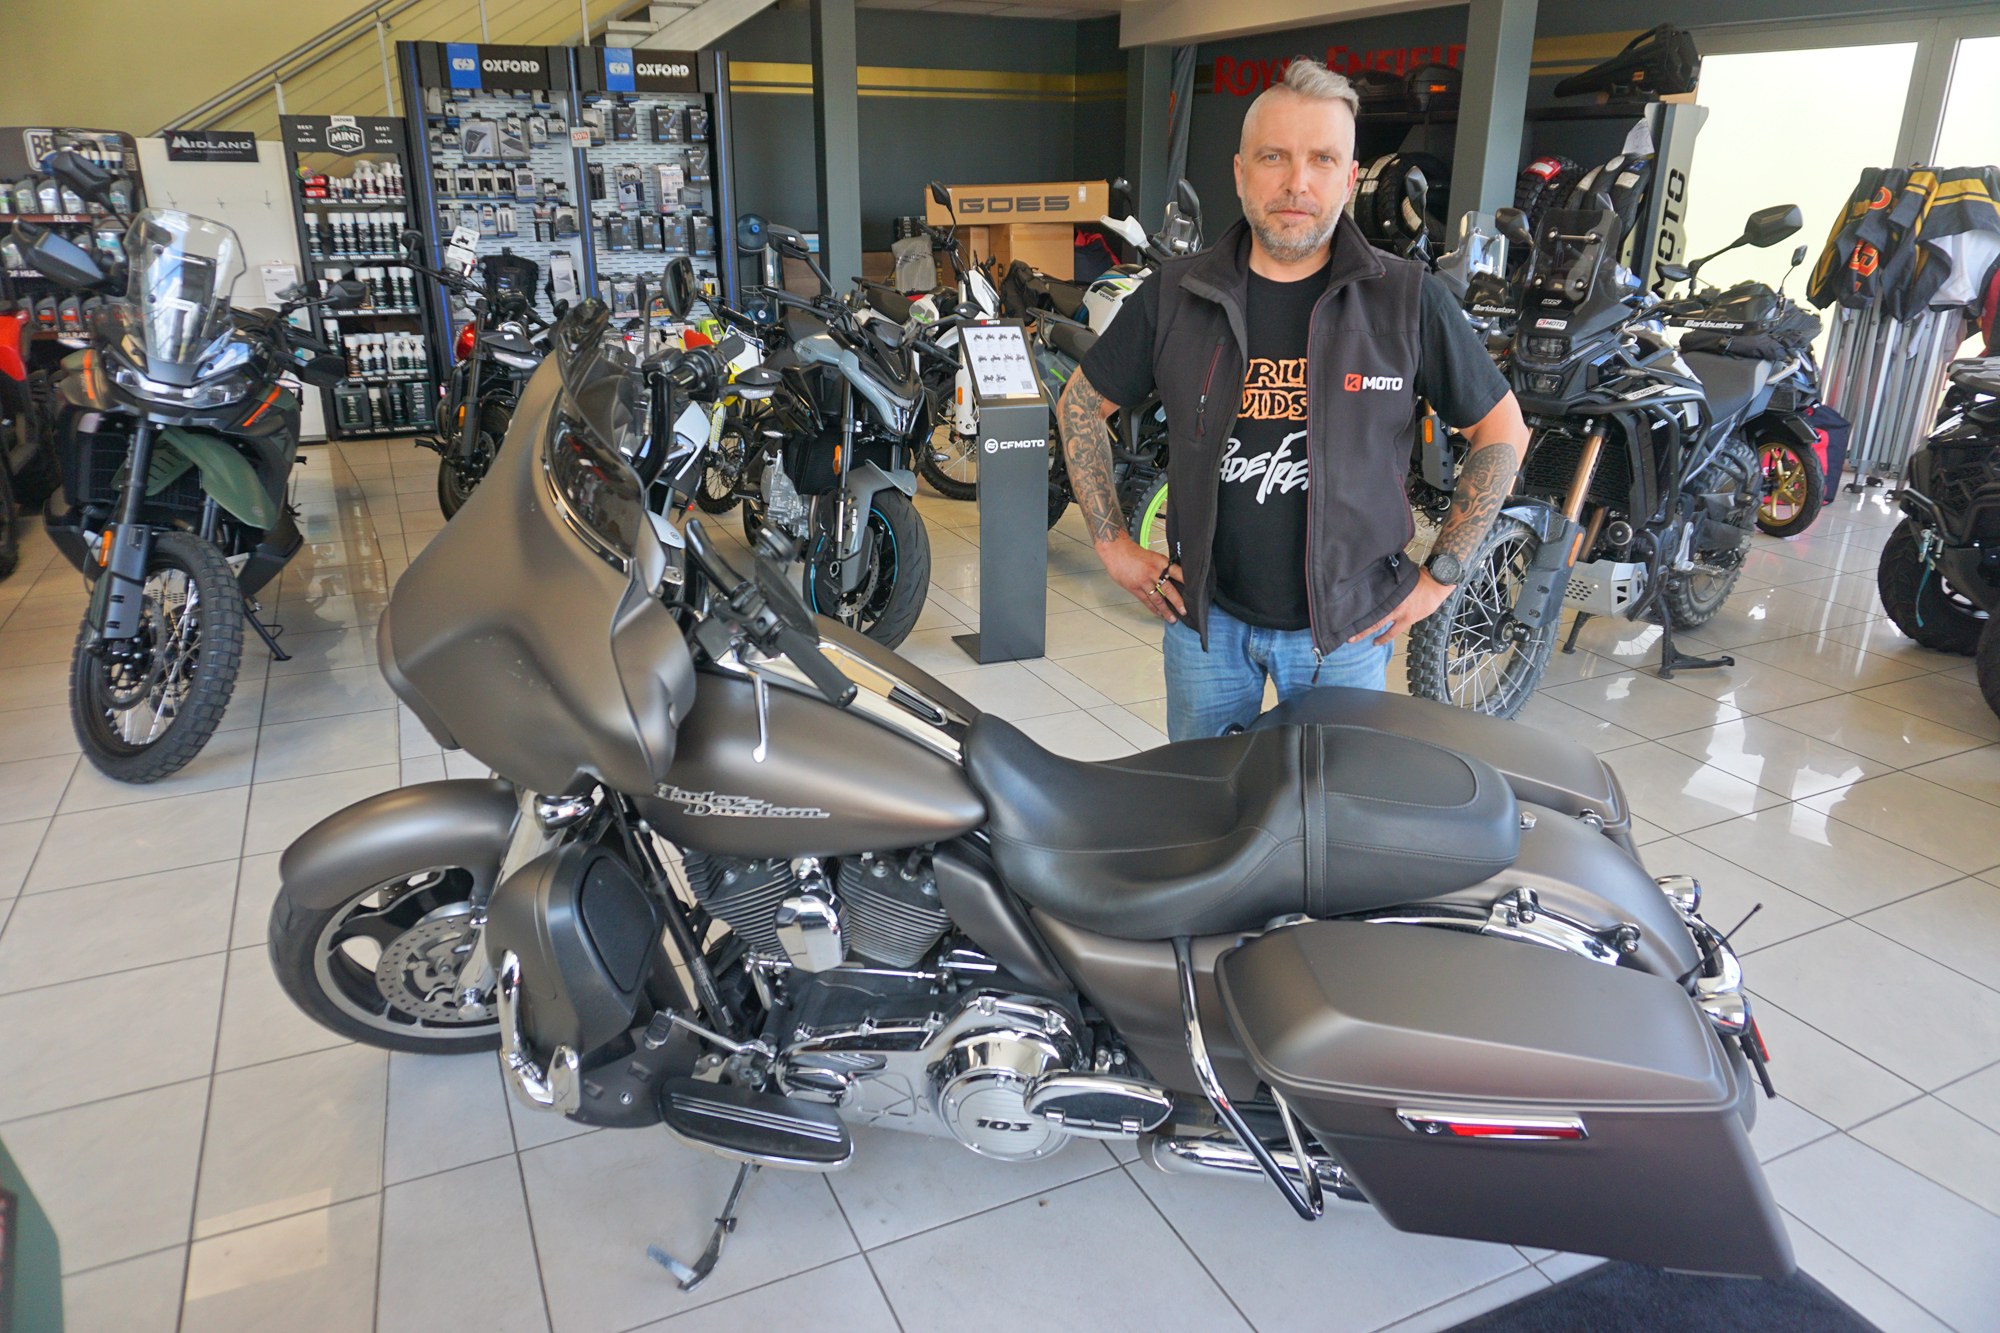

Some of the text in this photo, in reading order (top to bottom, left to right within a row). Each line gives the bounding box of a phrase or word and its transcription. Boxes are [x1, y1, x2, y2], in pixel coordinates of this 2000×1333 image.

[482, 58, 540, 73] OXFORD
[636, 63, 690, 77] OXFORD
[171, 135, 254, 150] MIDLAND
[331, 131, 360, 144] MINT
[572, 131, 589, 141] 30%
[959, 195, 1070, 214] GOES
[53, 214, 80, 222] FLEX
[1472, 303, 1517, 314] Barkbusters
[1684, 319, 1744, 330] Barkbusters
[1362, 376, 1404, 391] MOTO
[1000, 439, 1046, 450] CFMOTO
[683, 801, 831, 819] Davidson
[976, 1118, 1033, 1132] 103
